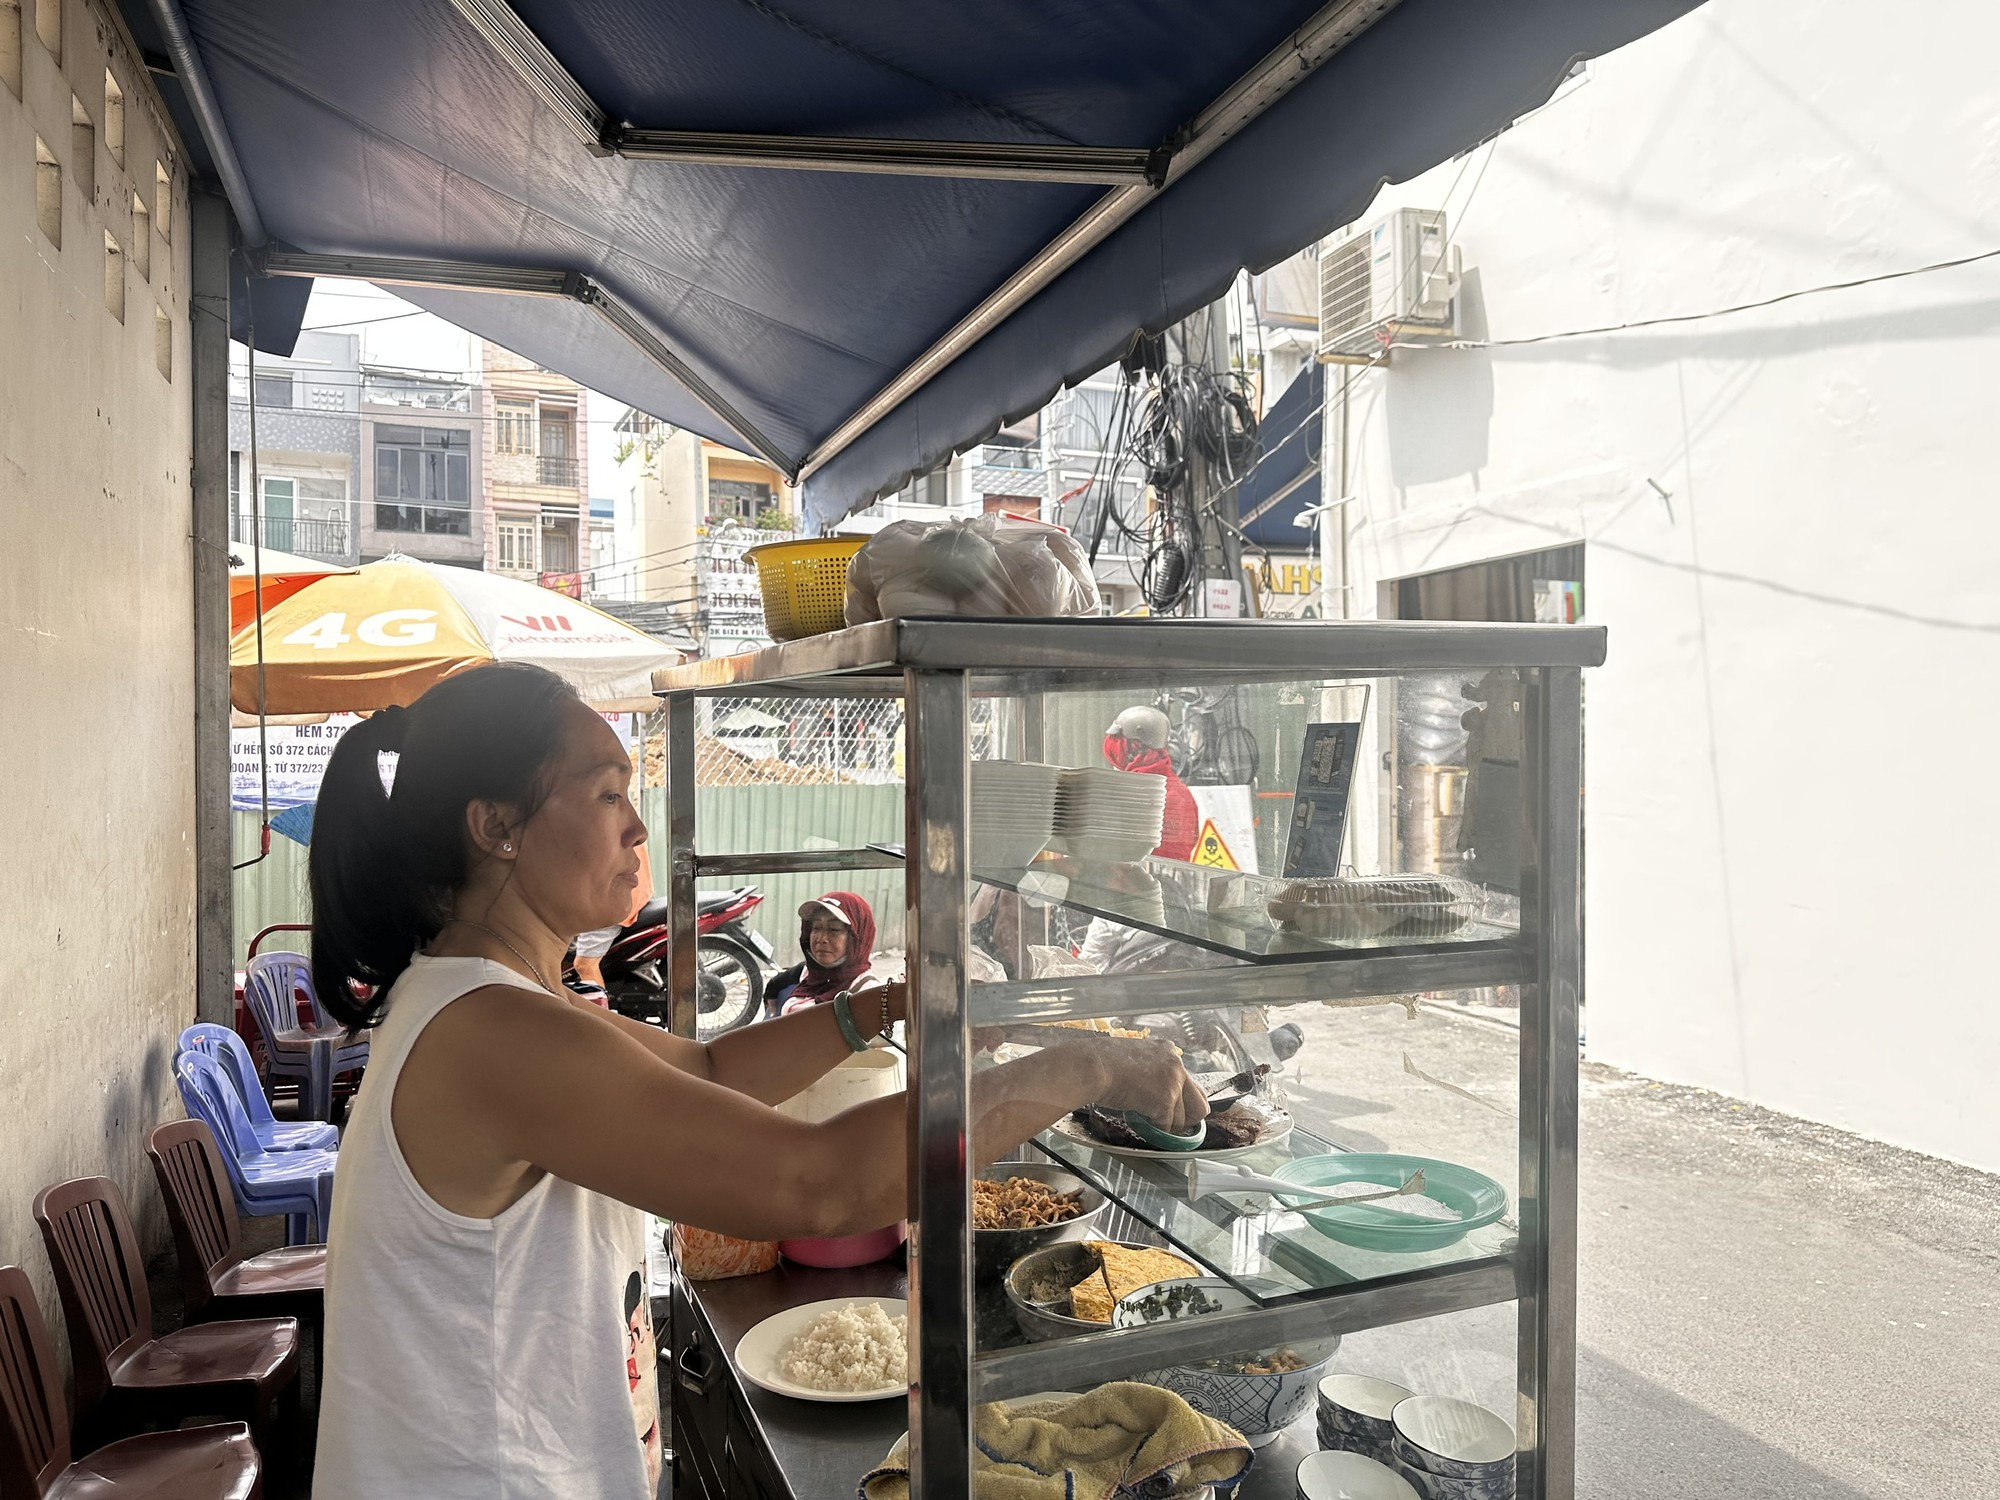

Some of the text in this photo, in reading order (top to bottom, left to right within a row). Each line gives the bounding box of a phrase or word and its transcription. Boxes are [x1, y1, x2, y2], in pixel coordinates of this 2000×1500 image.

[282, 608, 438, 649] 4G
[269, 741, 283, 755] SỐ
[286, 745, 304, 756] 372
